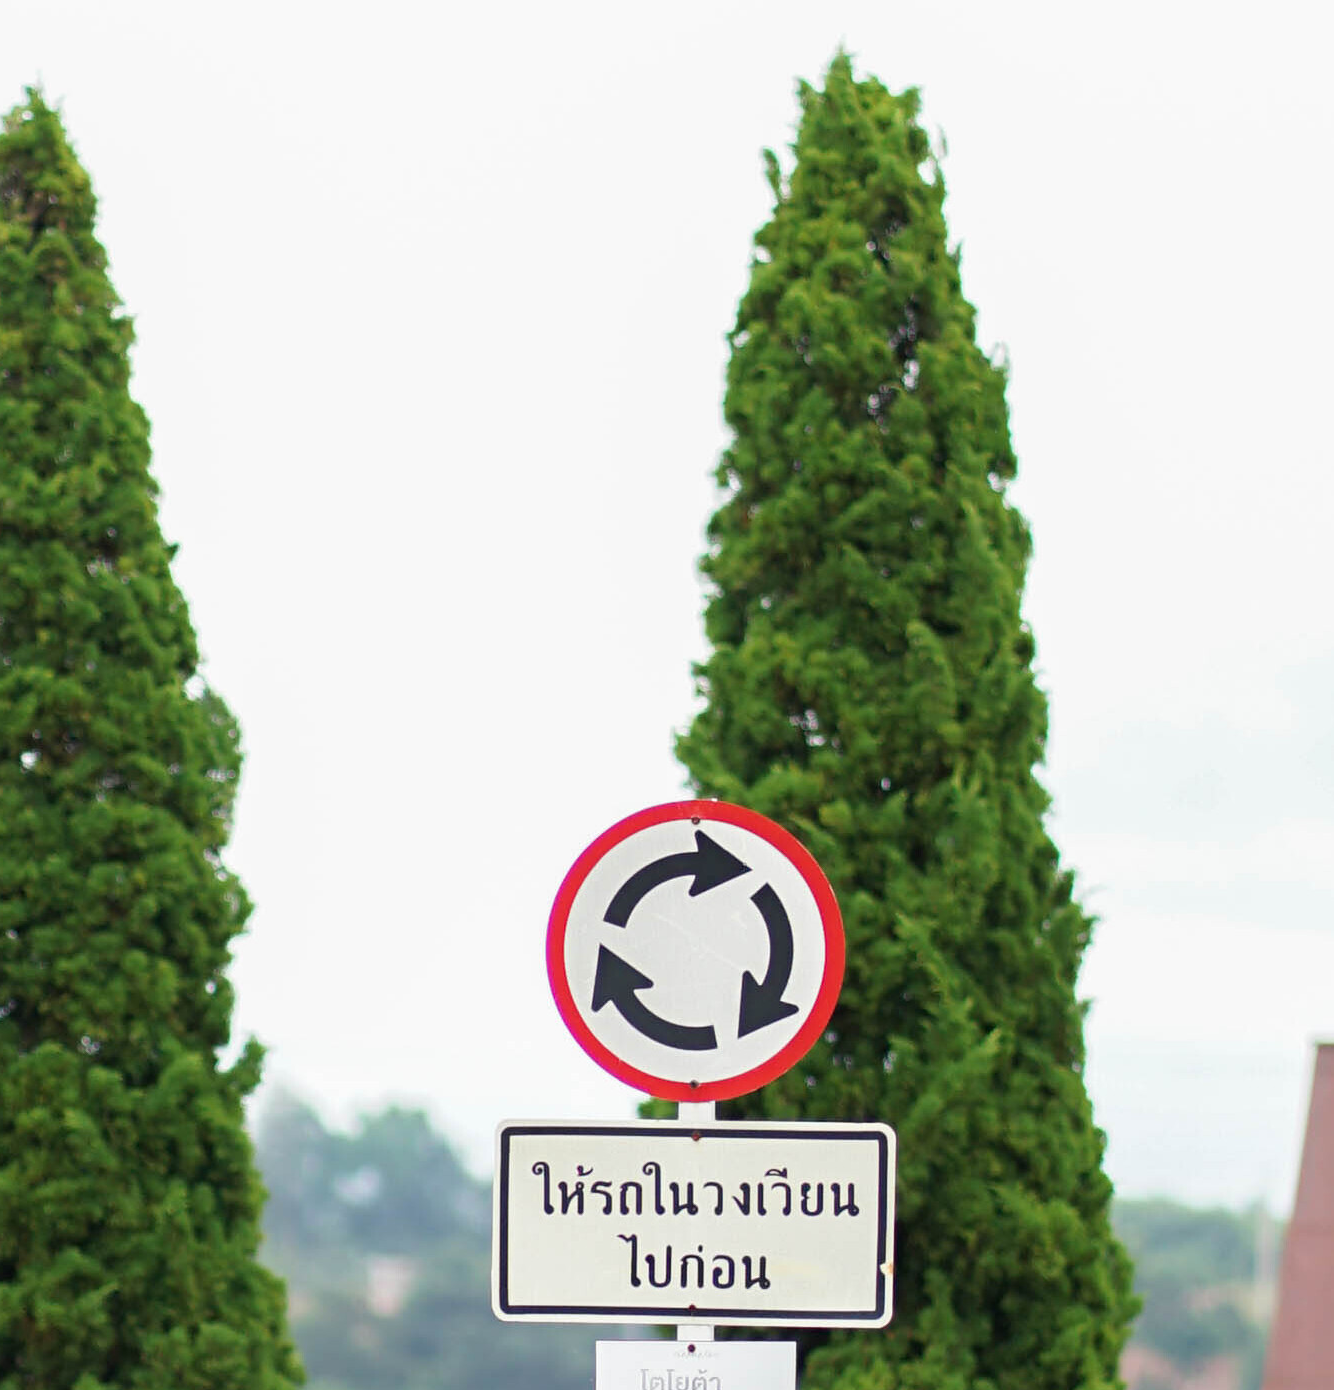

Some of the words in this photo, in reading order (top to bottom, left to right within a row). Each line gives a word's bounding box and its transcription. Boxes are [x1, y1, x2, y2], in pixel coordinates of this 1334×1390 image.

[531, 1161, 860, 1217] ให้รถในวงเวียน
[617, 1234, 771, 1290] ไปก่อน
